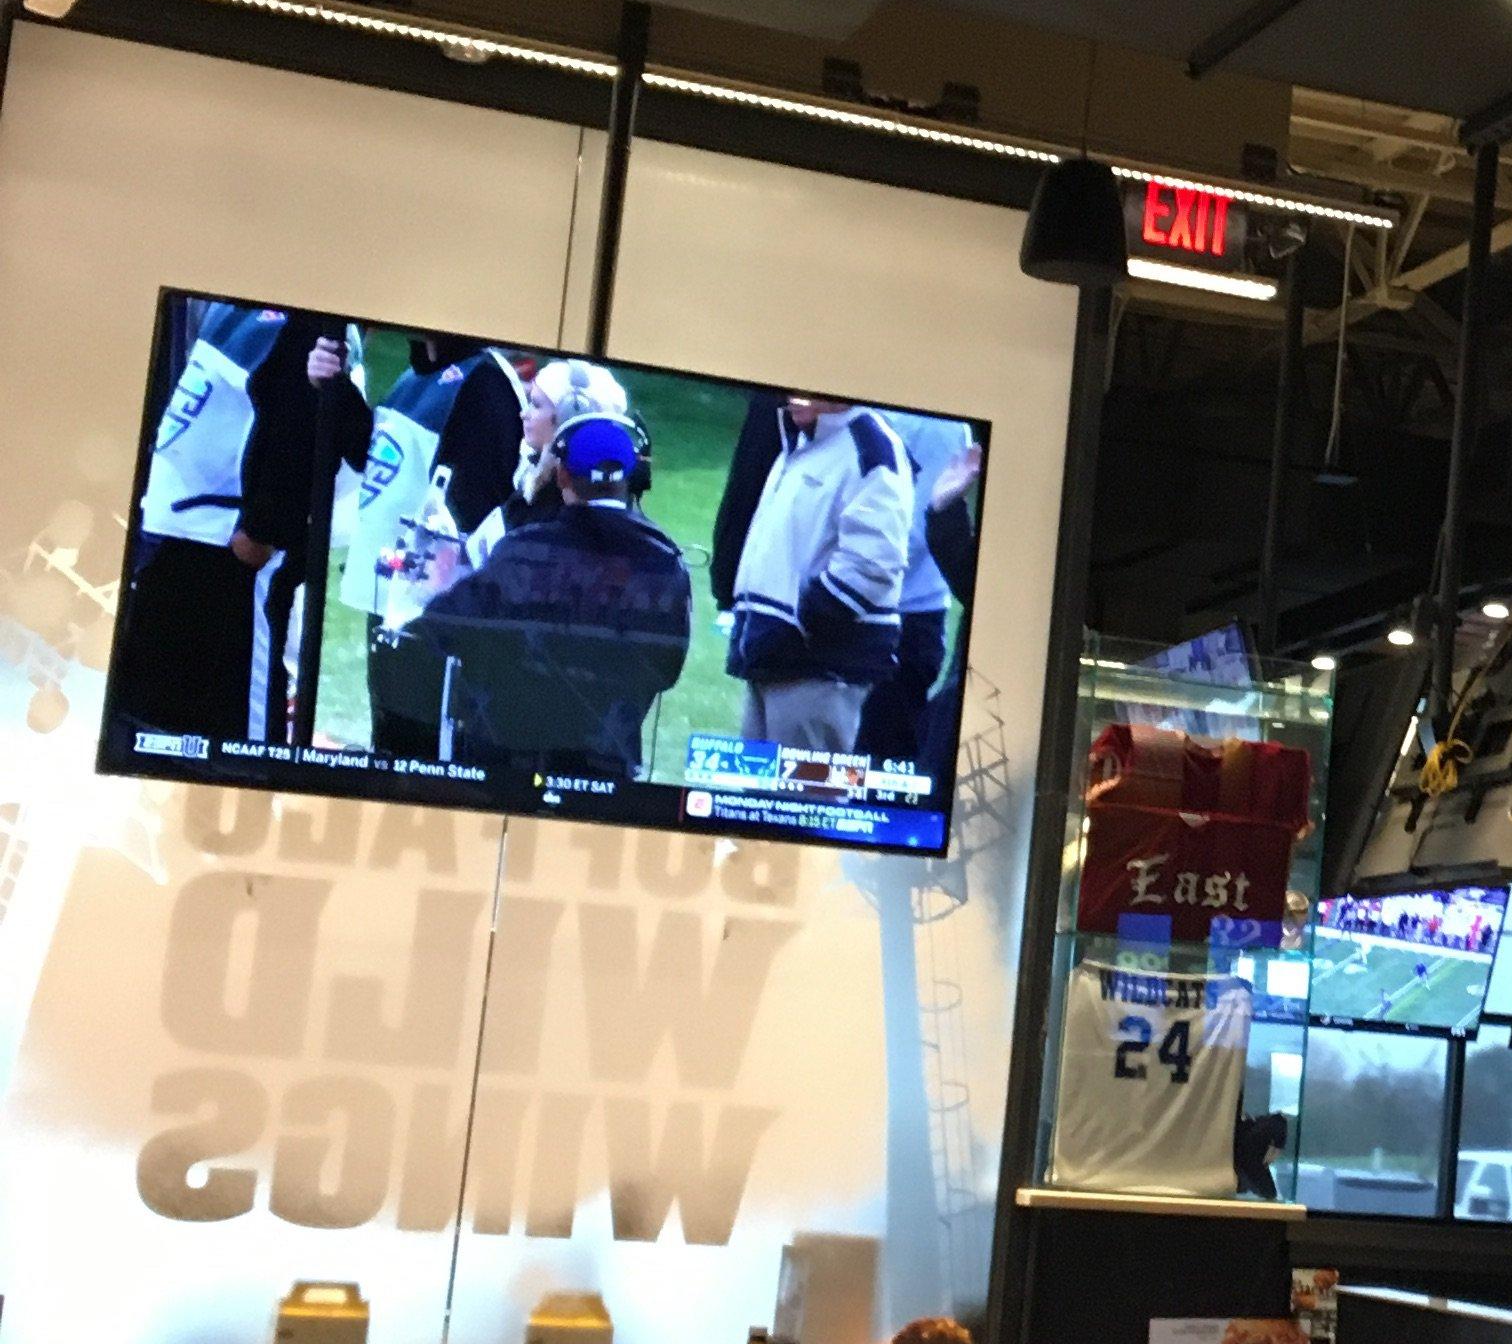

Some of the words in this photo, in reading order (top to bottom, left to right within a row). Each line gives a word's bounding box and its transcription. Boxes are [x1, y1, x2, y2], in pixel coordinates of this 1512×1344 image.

[1142, 178, 1233, 256] EXIT
[221, 741, 265, 758] NCAAF
[302, 749, 369, 769] Maryland
[409, 759, 446, 777] Penn
[448, 763, 486, 782] State
[689, 750, 722, 772] 34
[781, 760, 797, 779] 7
[545, 774, 572, 790] 3:30
[573, 779, 589, 793] ET
[590, 780, 615, 795] SAT
[714, 793, 775, 811] MONDAY
[775, 797, 816, 815] NIGHT
[817, 803, 890, 824] FOOTBALL
[1125, 853, 1251, 912] East
[1114, 1015, 1192, 1084] 24
